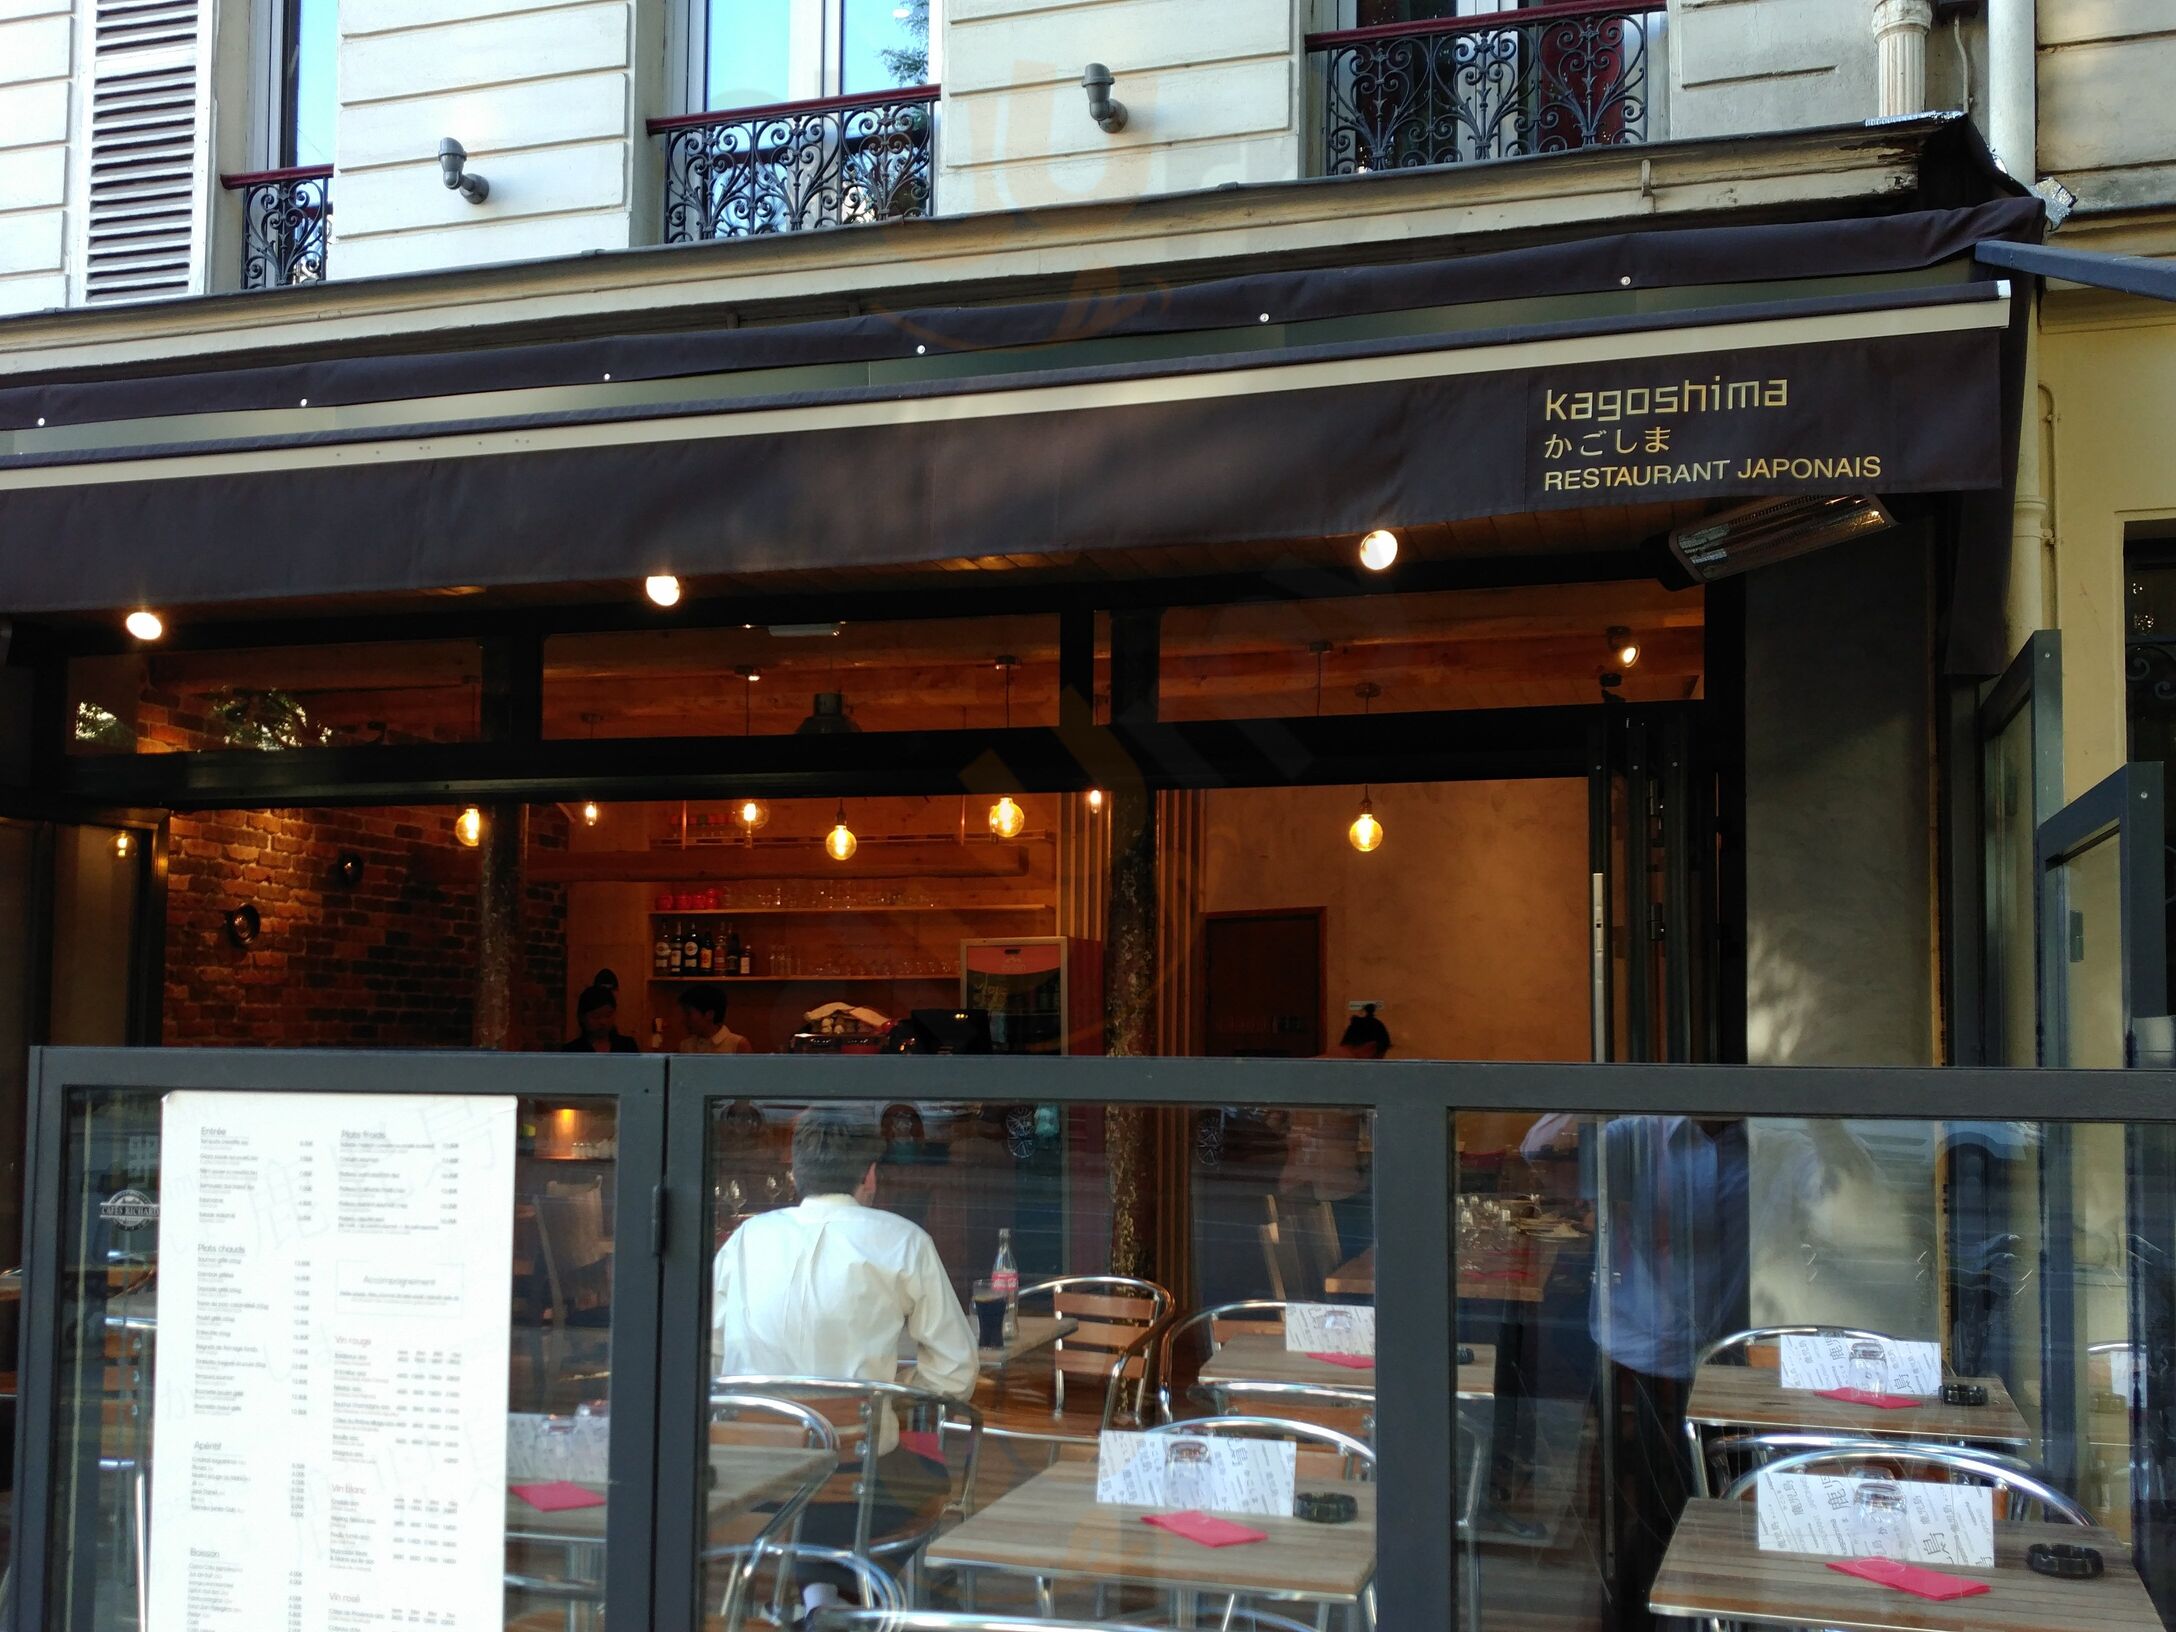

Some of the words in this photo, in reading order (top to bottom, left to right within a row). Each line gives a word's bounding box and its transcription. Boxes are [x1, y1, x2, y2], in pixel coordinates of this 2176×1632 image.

[1545, 375, 1788, 422] kagoshima
[1544, 426, 1671, 459] かごしま
[1544, 459, 1730, 491] RESTAURANT
[1737, 455, 1882, 480] JAPONAIS
